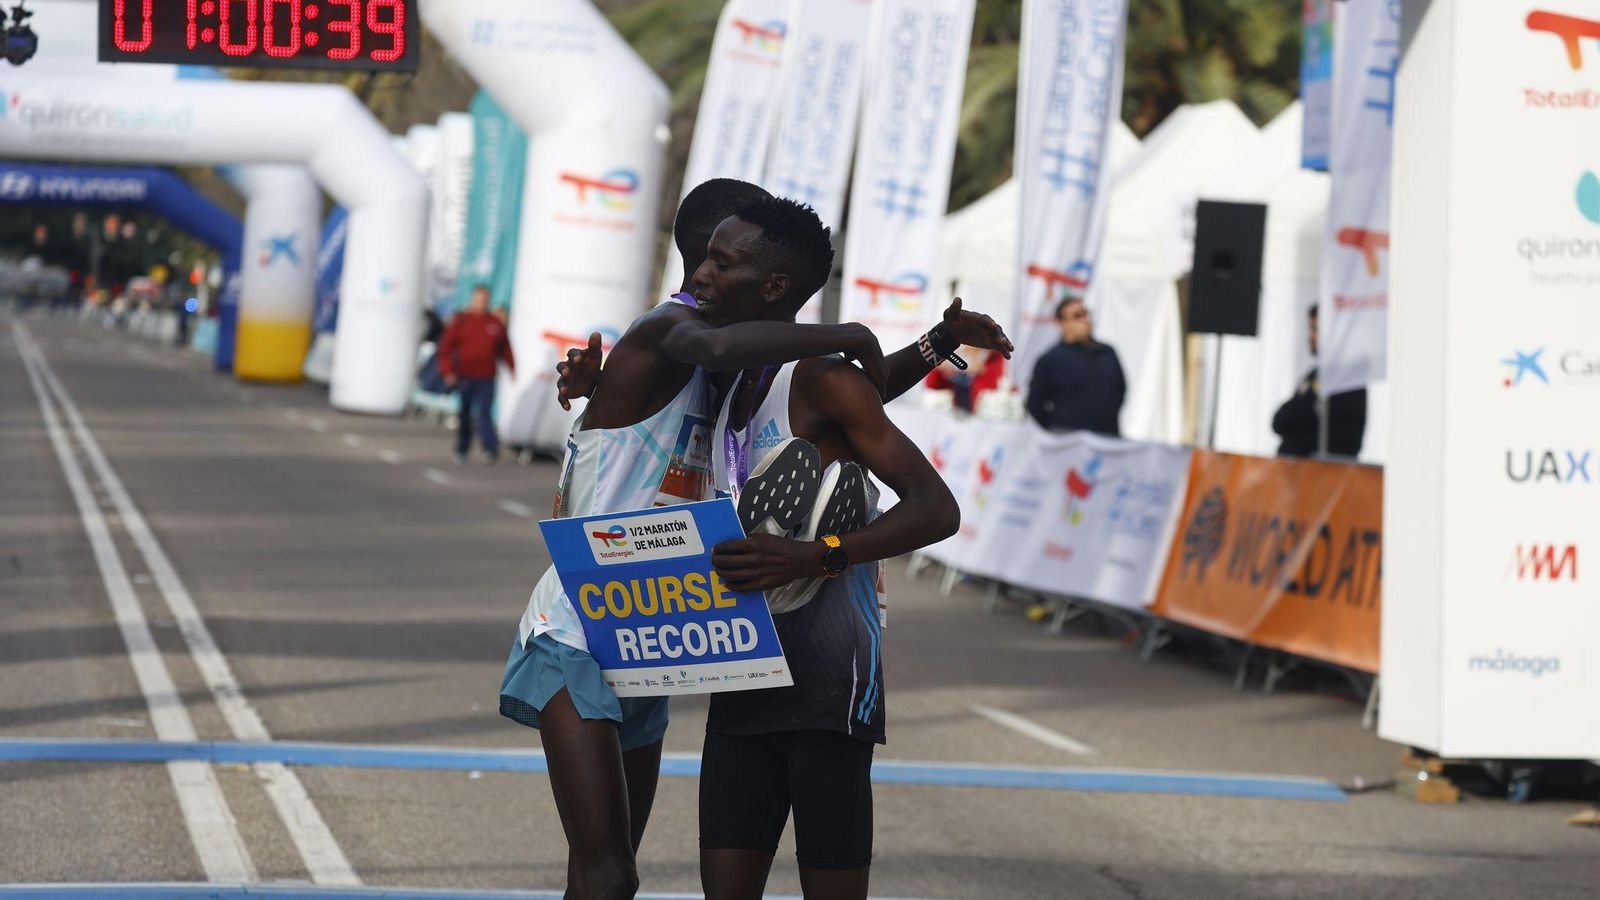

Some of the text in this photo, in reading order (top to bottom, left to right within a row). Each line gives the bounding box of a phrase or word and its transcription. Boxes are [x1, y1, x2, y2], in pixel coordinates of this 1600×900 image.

[114, 0, 405, 61] 01:00:39
[1506, 451, 1590, 481] UAX
[629, 520, 688, 537] 1/2 MARATÓN
[634, 536, 686, 550] DE MÁLAGA
[600, 550, 634, 559] TotalEnergies
[578, 570, 737, 620] COURSE
[615, 617, 759, 661] RECORD
[1468, 647, 1561, 677] málaga
